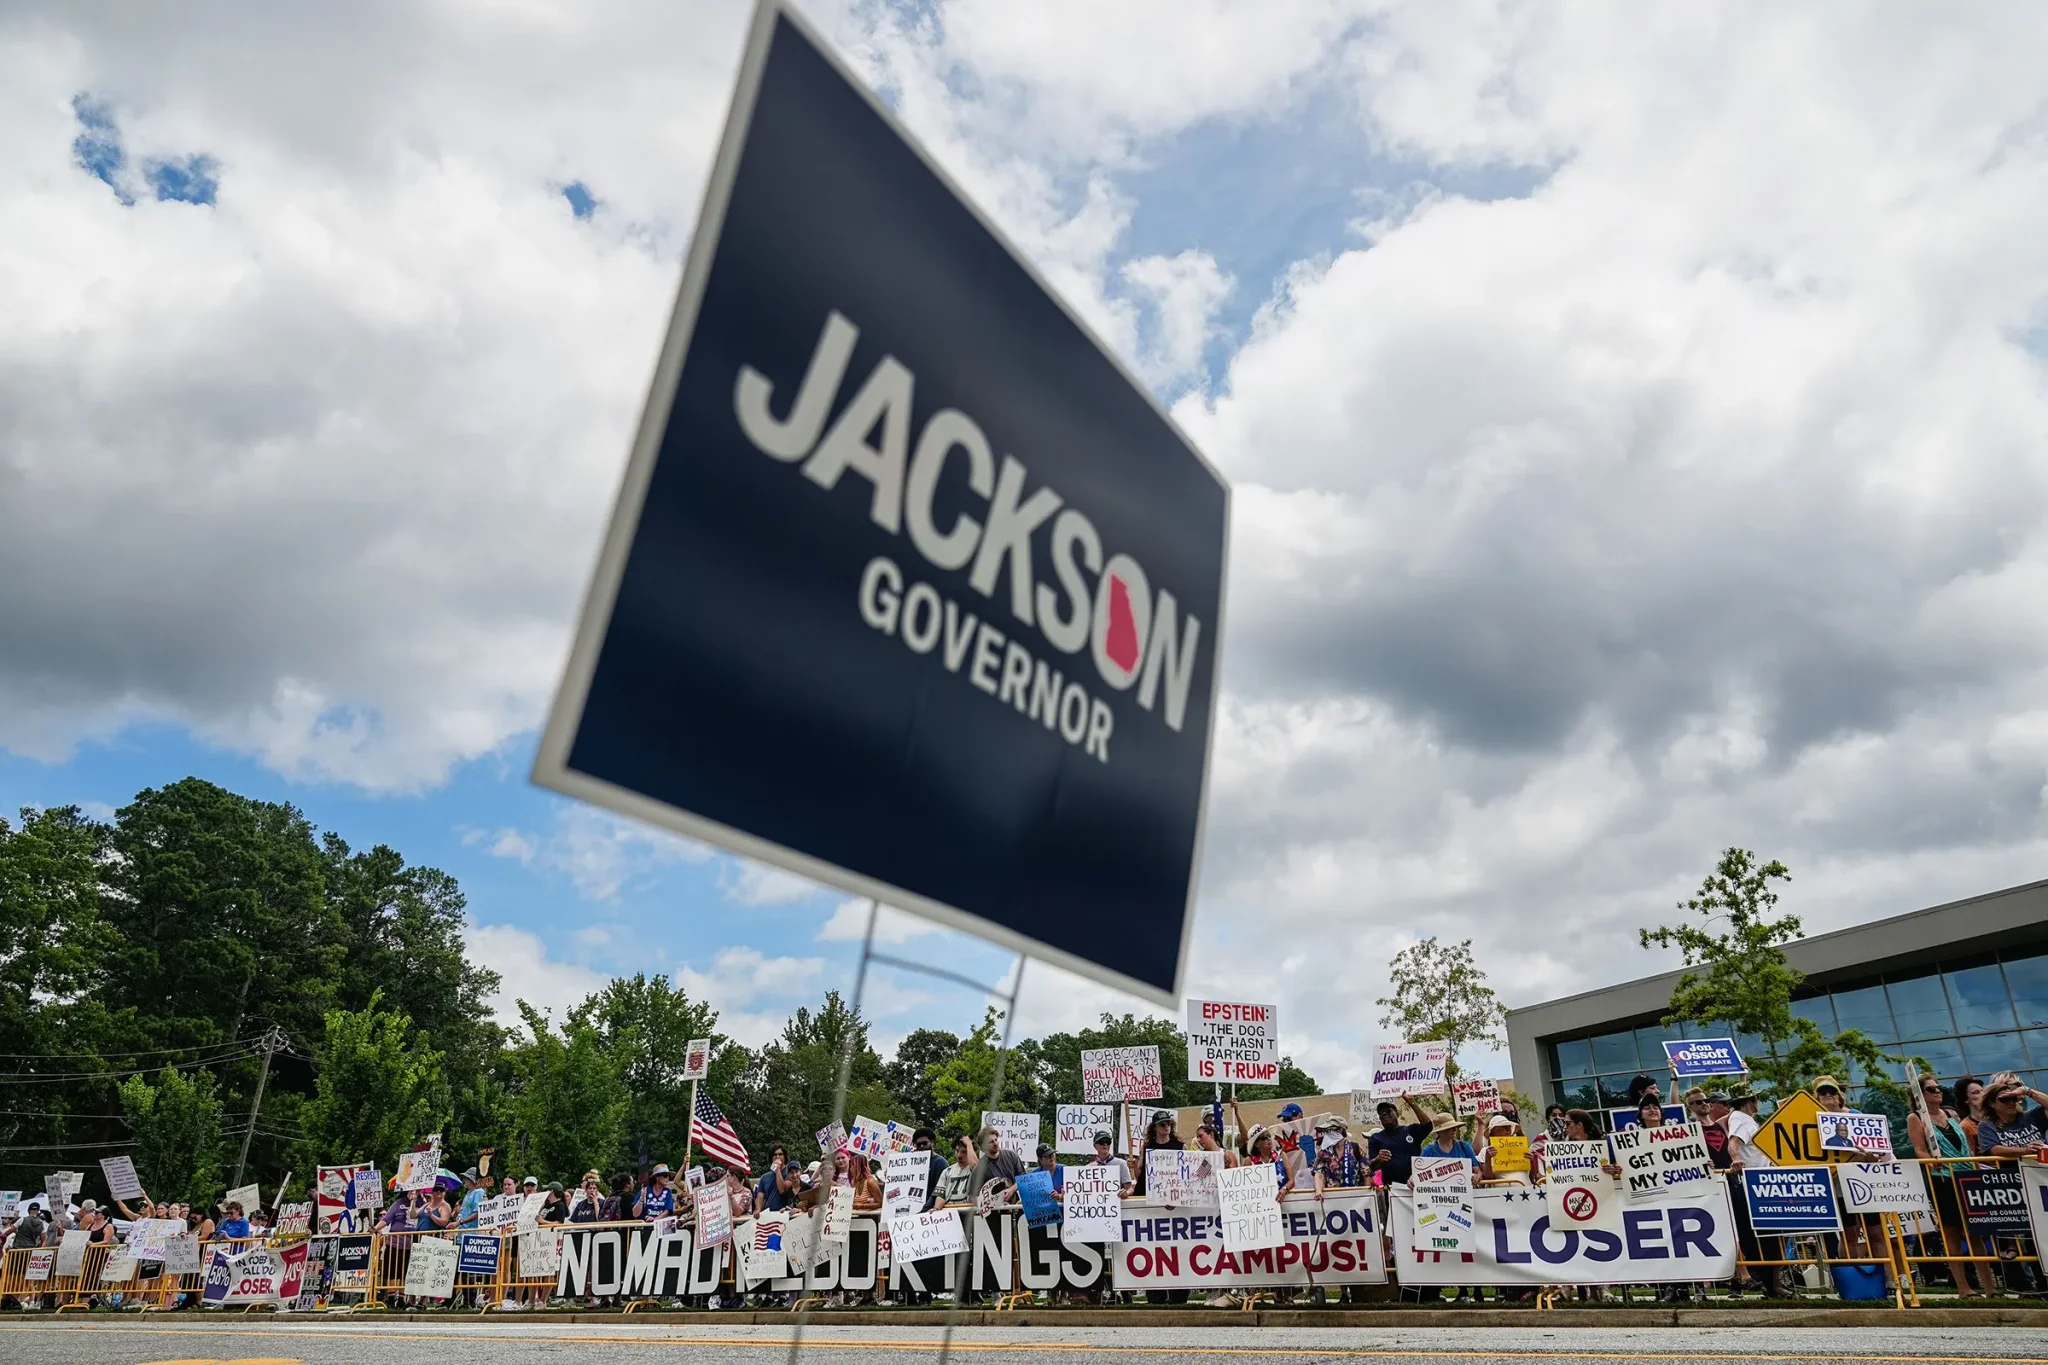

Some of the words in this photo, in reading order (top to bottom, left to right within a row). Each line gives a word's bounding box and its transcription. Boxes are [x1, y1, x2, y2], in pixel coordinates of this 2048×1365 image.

[732, 308, 1200, 733] JACKSON
[858, 556, 1114, 764] GOVERNOR
[1202, 1003, 1270, 1022] EPSTEIN:
[1239, 1025, 1265, 1037] DOG
[1192, 1034, 1225, 1047] THAT
[1689, 1043, 1713, 1052] Jon
[1380, 1051, 1419, 1065] TRUMP
[1678, 1048, 1730, 1061] Ossoff
[1102, 1059, 1130, 1069] RULE
[1200, 1061, 1214, 1077] IS
[1223, 1061, 1277, 1080] TRUMP
[1084, 1066, 1134, 1081] BULLYING
[1143, 1064, 1155, 1076] IS
[1374, 1066, 1444, 1084] ACCOUNTABILITY
[1088, 1079, 1110, 1090] NOW
[1128, 1085, 1160, 1093] ALLOWED
[1354, 1092, 1366, 1105] NO
[1459, 1088, 1498, 1102] STRONGER
[1477, 1099, 1498, 1112] HATE
[984, 1112, 1006, 1126] Cobb
[1011, 1114, 1029, 1128] Has
[1057, 1106, 1088, 1126] Cobb
[1090, 1105, 1113, 1125] Said
[1821, 1115, 1884, 1128] PROTECT
[1853, 1126, 1883, 1137] OUR
[1997, 1124, 2039, 1141] KAMALA
[1499, 1138, 1524, 1149] Silence
[1614, 1131, 1640, 1150] HEY
[1774, 1122, 1841, 1163] NO
[1851, 1136, 1889, 1149] VOTE!
[1546, 1143, 1584, 1157] NOBODY
[1589, 1143, 1604, 1155] AT
[1629, 1151, 1656, 1169] GET
[1661, 1143, 1705, 1163] OUTTA
[888, 1157, 908, 1168] PLACES
[910, 1156, 928, 1166] TRUMP
[1550, 1156, 1599, 1172] WHEELER
[1078, 1168, 1107, 1180] KEEP
[1417, 1171, 1434, 1183] NOW
[1435, 1160, 1464, 1178] SHOWING
[1857, 1163, 1902, 1175] VOTE
[356, 1171, 380, 1181] RESPECT
[919, 1173, 926, 1181] BE
[1219, 1165, 1274, 1188] WORST
[1552, 1174, 1575, 1184] WANTS
[1579, 1173, 1600, 1184] THIS
[1629, 1172, 1659, 1191] MY
[1663, 1163, 1713, 1186] SCHOOL!
[1758, 1173, 1815, 1184] DUMONT
[1982, 1173, 2022, 1184] CHRIS
[1066, 1180, 1120, 1193] POLITICS
[1165, 1179, 1182, 1189] ARE
[1416, 1186, 1446, 1194] GEORGIA'S
[356, 1191, 382, 1201] EXPECT
[1222, 1185, 1275, 1203] PRESIDENT
[1752, 1184, 1827, 1198] WALKER
[1967, 1188, 2026, 1207] HARD
[479, 1201, 499, 1214] TRUMP
[503, 1196, 520, 1208] LOST
[828, 1198, 845, 1210] Are
[1071, 1194, 1091, 1205] OUT
[1097, 1194, 1109, 1205] OF
[1431, 1195, 1460, 1204] STOOGES
[1069, 1206, 1119, 1219] SCHOOLS
[1231, 1201, 1274, 1216] SINCE...
[1813, 1205, 1828, 1214] 46
[479, 1215, 495, 1226] COBB
[498, 1210, 520, 1222] COUNT
[891, 1219, 915, 1235] NO
[920, 1212, 953, 1227] Blood
[1447, 1210, 1472, 1229] Jackson
[1223, 1214, 1278, 1243] TRUMP
[468, 1238, 495, 1246] DUMONT
[894, 1234, 915, 1247] For
[1491, 1207, 1722, 1264] LOSER
[1432, 1237, 1459, 1248] TRUMP
[340, 1246, 370, 1257] JACKSON
[433, 1247, 458, 1259] CONGRESS
[464, 1245, 497, 1255] WALKER
[896, 1251, 912, 1263] No
[912, 1244, 930, 1259] War
[235, 1259, 246, 1268] IN
[1126, 1245, 1180, 1278] ON
[1189, 1239, 1369, 1277] CAMPUS!
[28, 1261, 50, 1270] COLLINS
[208, 1265, 230, 1287] 58%
[434, 1268, 450, 1279] YOUR
